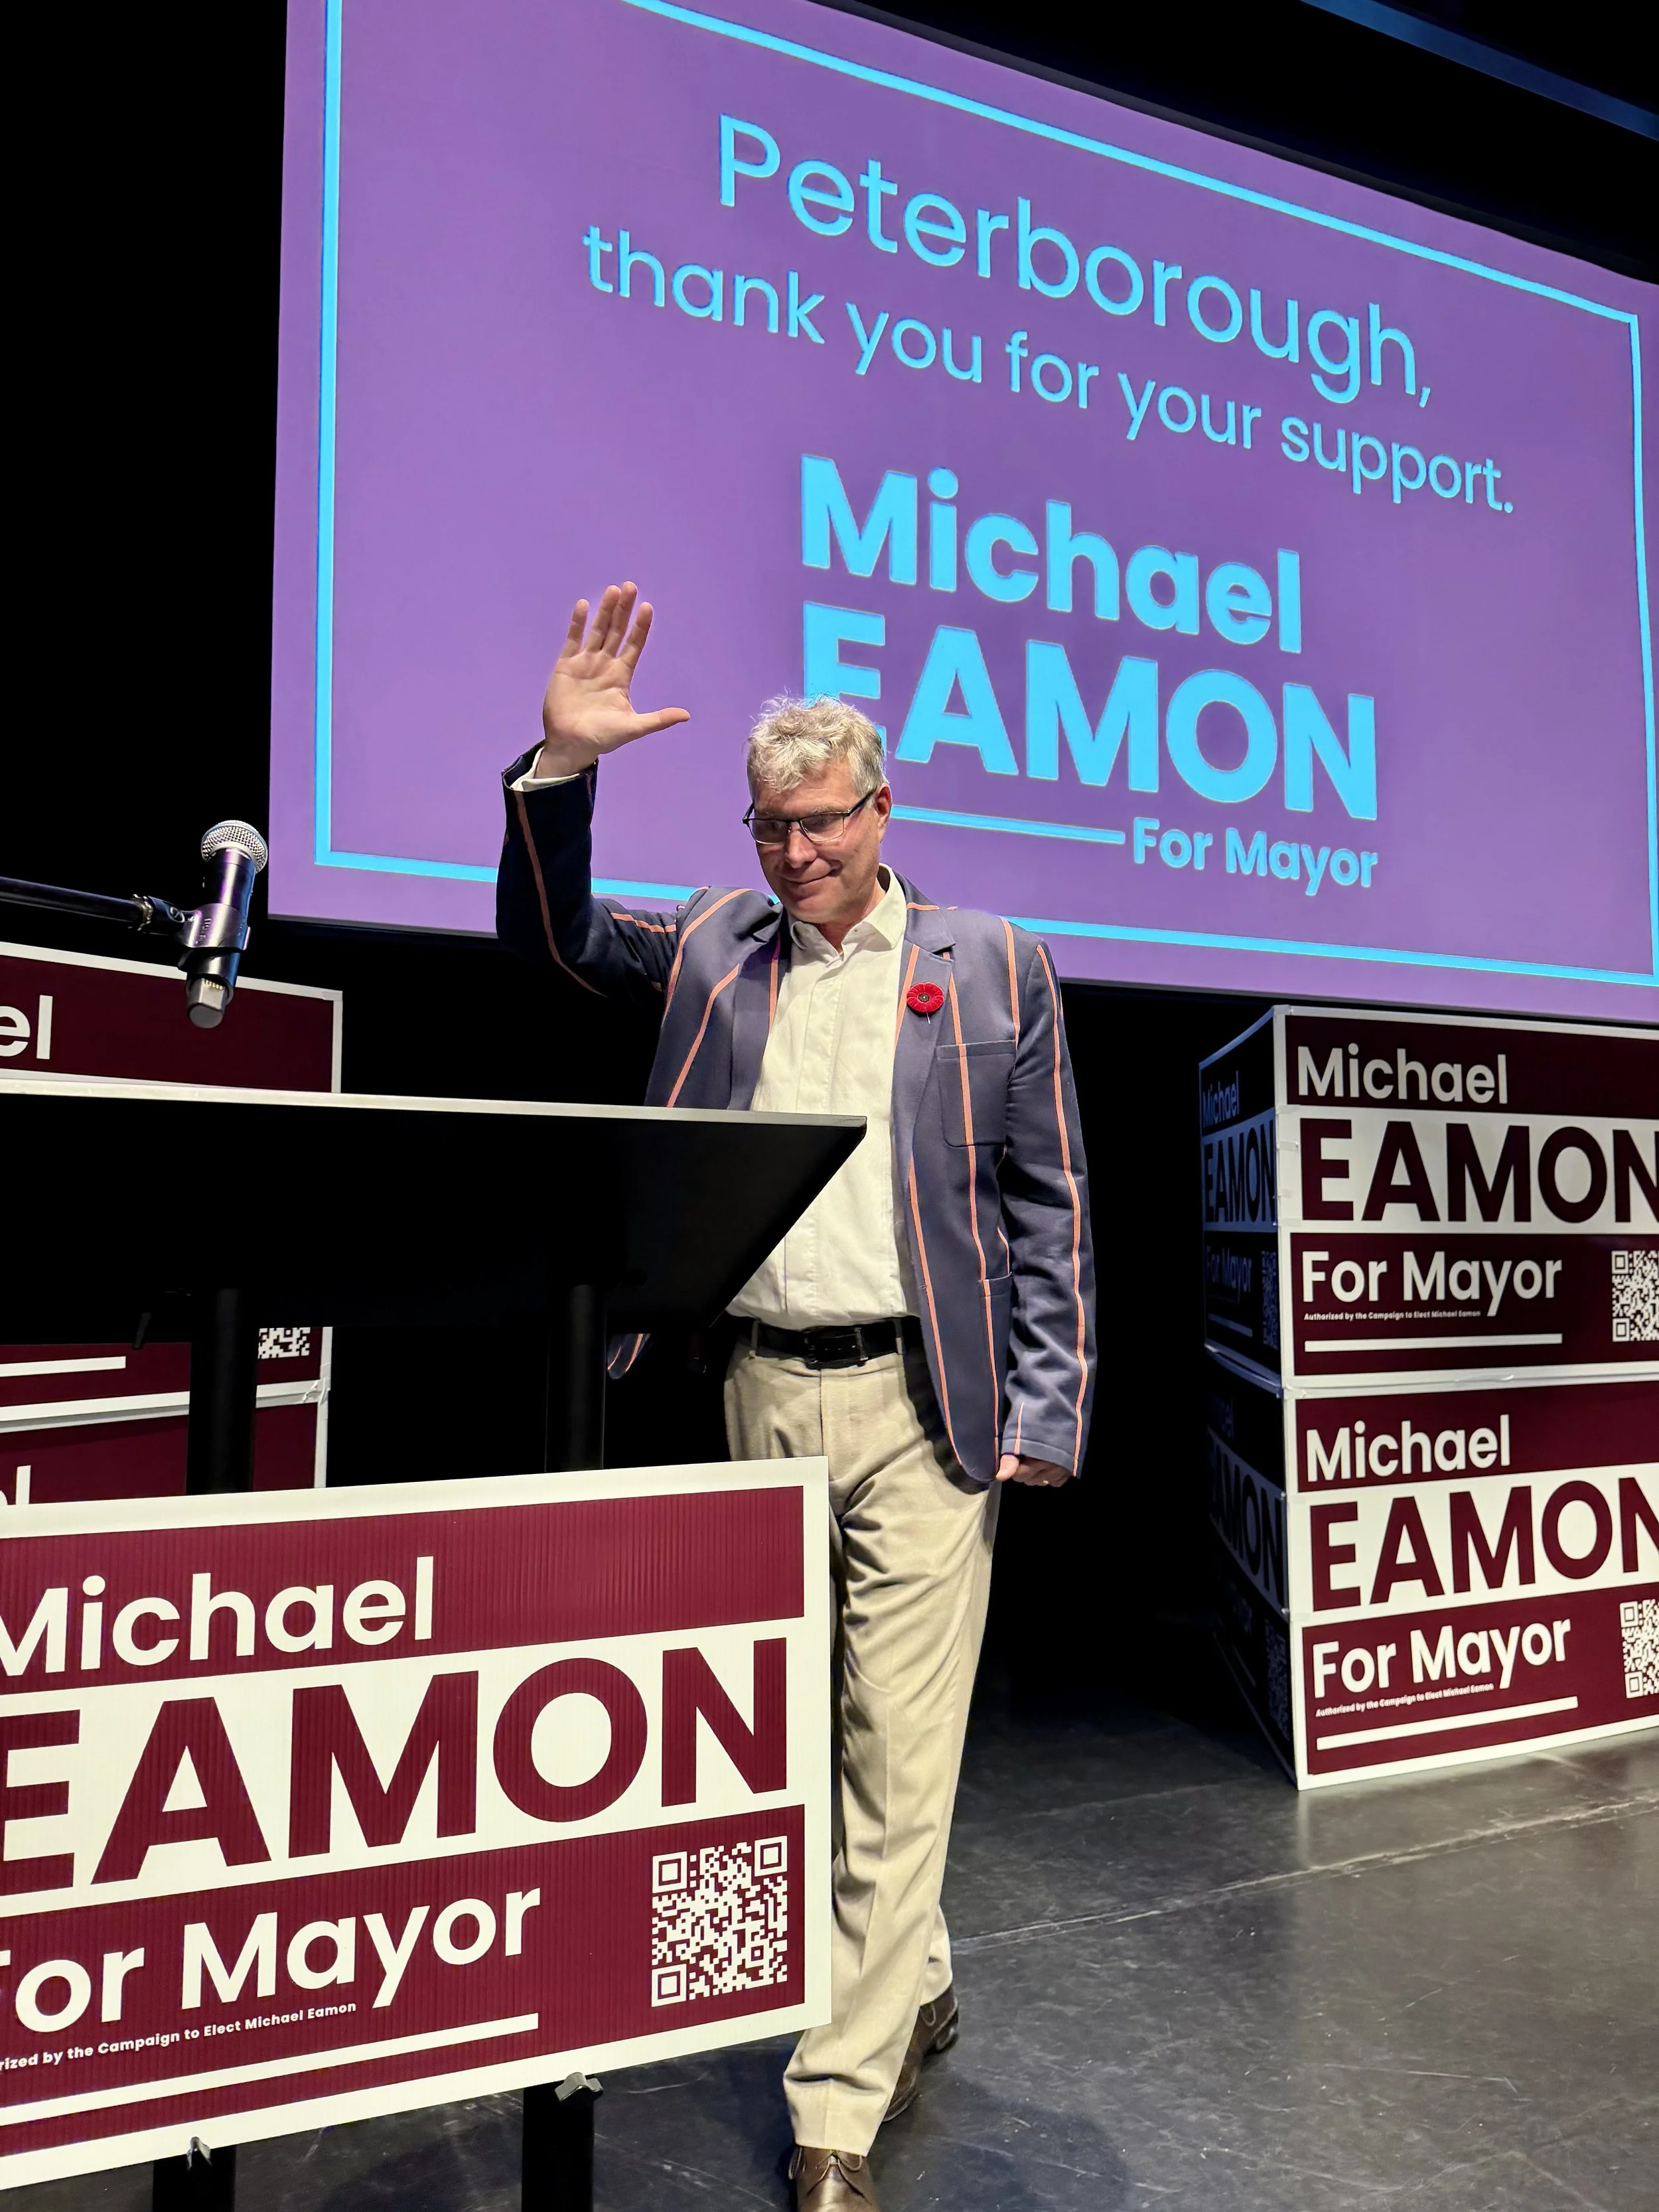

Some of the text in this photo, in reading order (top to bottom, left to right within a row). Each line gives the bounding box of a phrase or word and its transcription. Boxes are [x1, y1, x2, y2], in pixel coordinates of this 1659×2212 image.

[719, 113, 1431, 407] Peterborough,
[581, 225, 1515, 514] thank you for your support.
[800, 454, 1303, 654] Michael
[802, 600, 1378, 820] EAMON
[1132, 816, 1379, 896] For Mayor
[1297, 1042, 1508, 1104] Michael
[1204, 1120, 1275, 1222] EAMON
[1299, 1118, 1659, 1224] EAMON
[1302, 1250, 1563, 1317] For Mayor
[1303, 1311, 1344, 1321] Authorized
[1345, 1312, 1354, 1321] by
[1368, 1311, 1404, 1321] Campaign
[1306, 1414, 1511, 1483] Michael
[1310, 1477, 1659, 1613] EAMON
[0, 1556, 434, 1677] Michael
[1313, 1618, 1571, 1699] For Mayor
[1315, 1704, 1356, 1718] Authorized
[1356, 1702, 1366, 1712] by
[1366, 1700, 1379, 1710] the
[0, 1637, 788, 1897] EAMON
[0, 1887, 541, 2033] or Mayor
[42, 2051, 64, 2065] by
[67, 2047, 94, 2059] the
[98, 2033, 180, 2054] Campaign
[184, 2029, 200, 2040] to
[204, 2020, 241, 2037] Elect
[245, 2010, 303, 2030] Michael
[307, 2003, 356, 2019] Eamon
